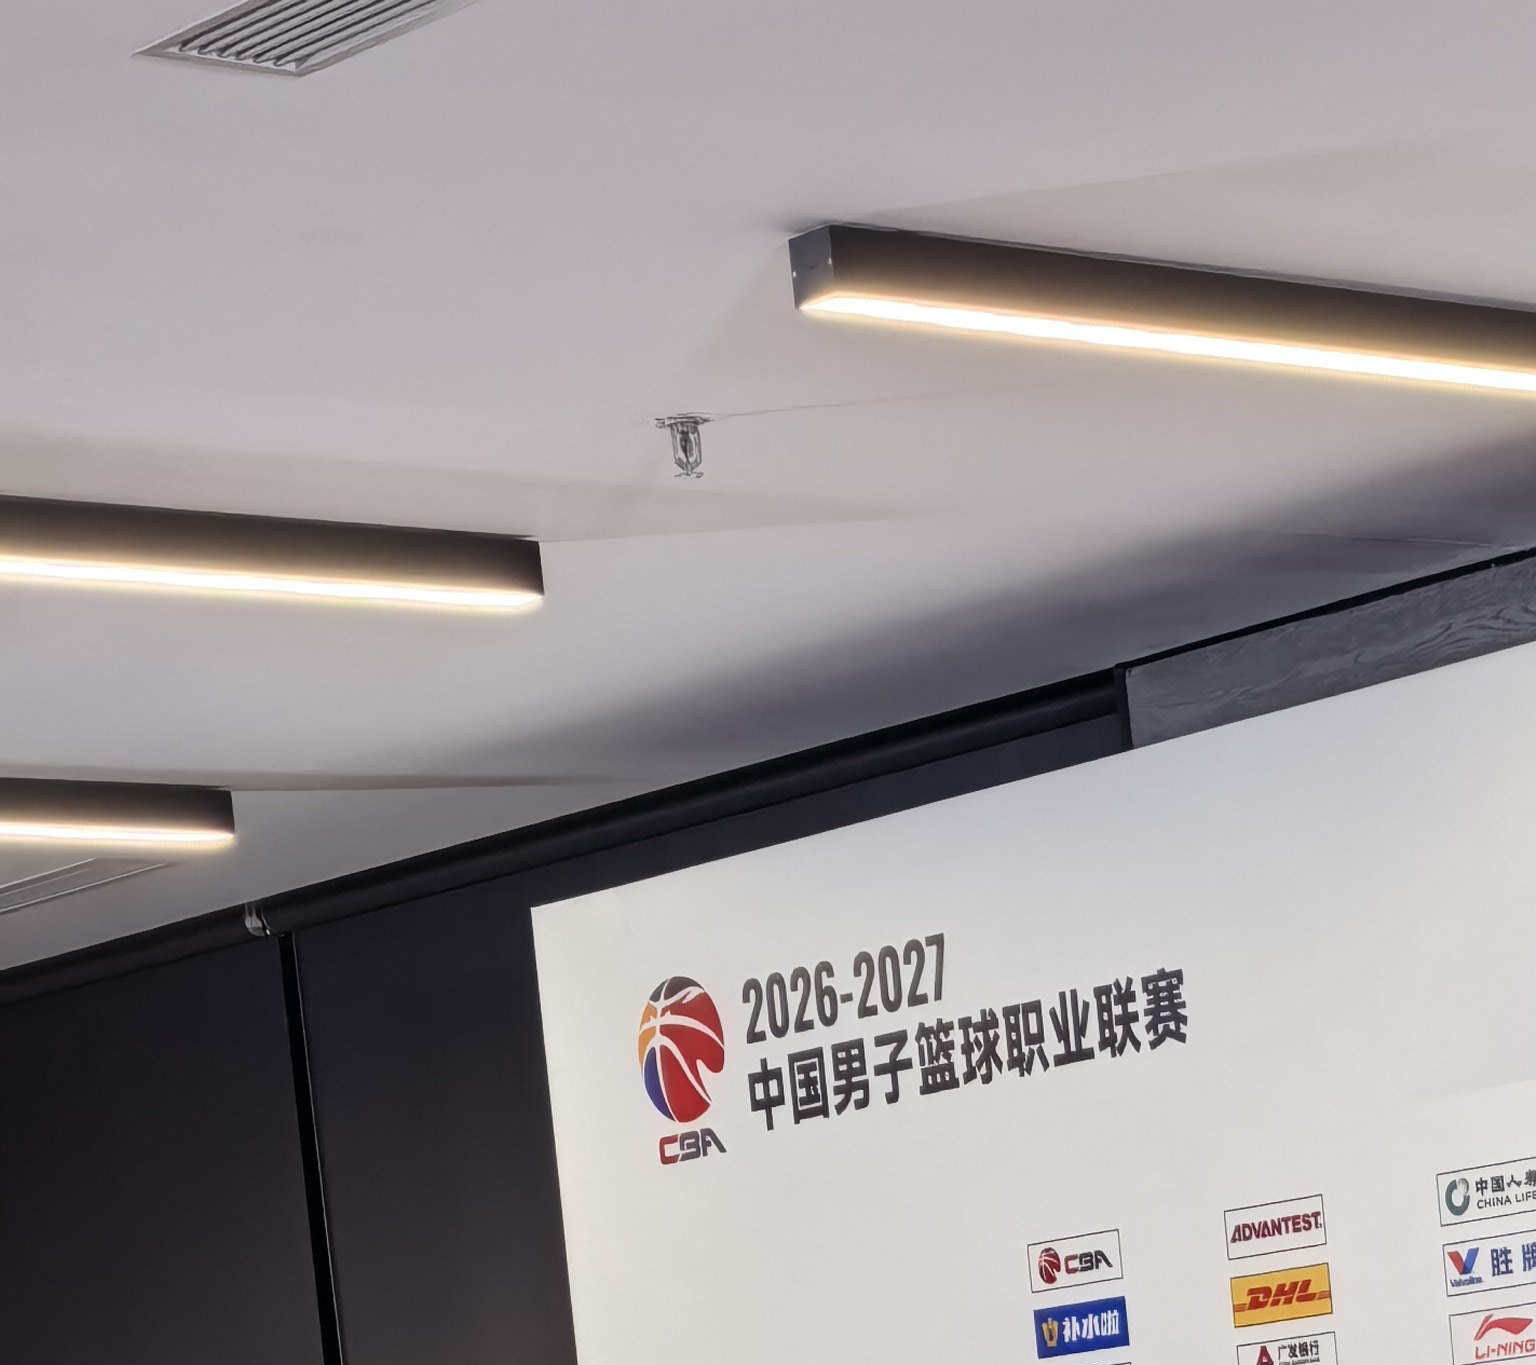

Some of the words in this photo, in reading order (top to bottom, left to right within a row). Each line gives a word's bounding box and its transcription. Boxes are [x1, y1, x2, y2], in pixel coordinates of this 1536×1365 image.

[742, 932, 945, 1044] 2026-2027
[748, 967, 1190, 1131] 中国男子篮球职业联赛
[659, 1127, 726, 1166] CBA
[1476, 1194, 1512, 1210] CHINA
[1231, 1210, 1322, 1243] ADVANTEST
[1064, 1250, 1113, 1275] CBA
[1246, 1279, 1318, 1310] DHL
[1062, 1309, 1120, 1343] 补水啦
[1474, 1339, 1536, 1360] LI-NING
